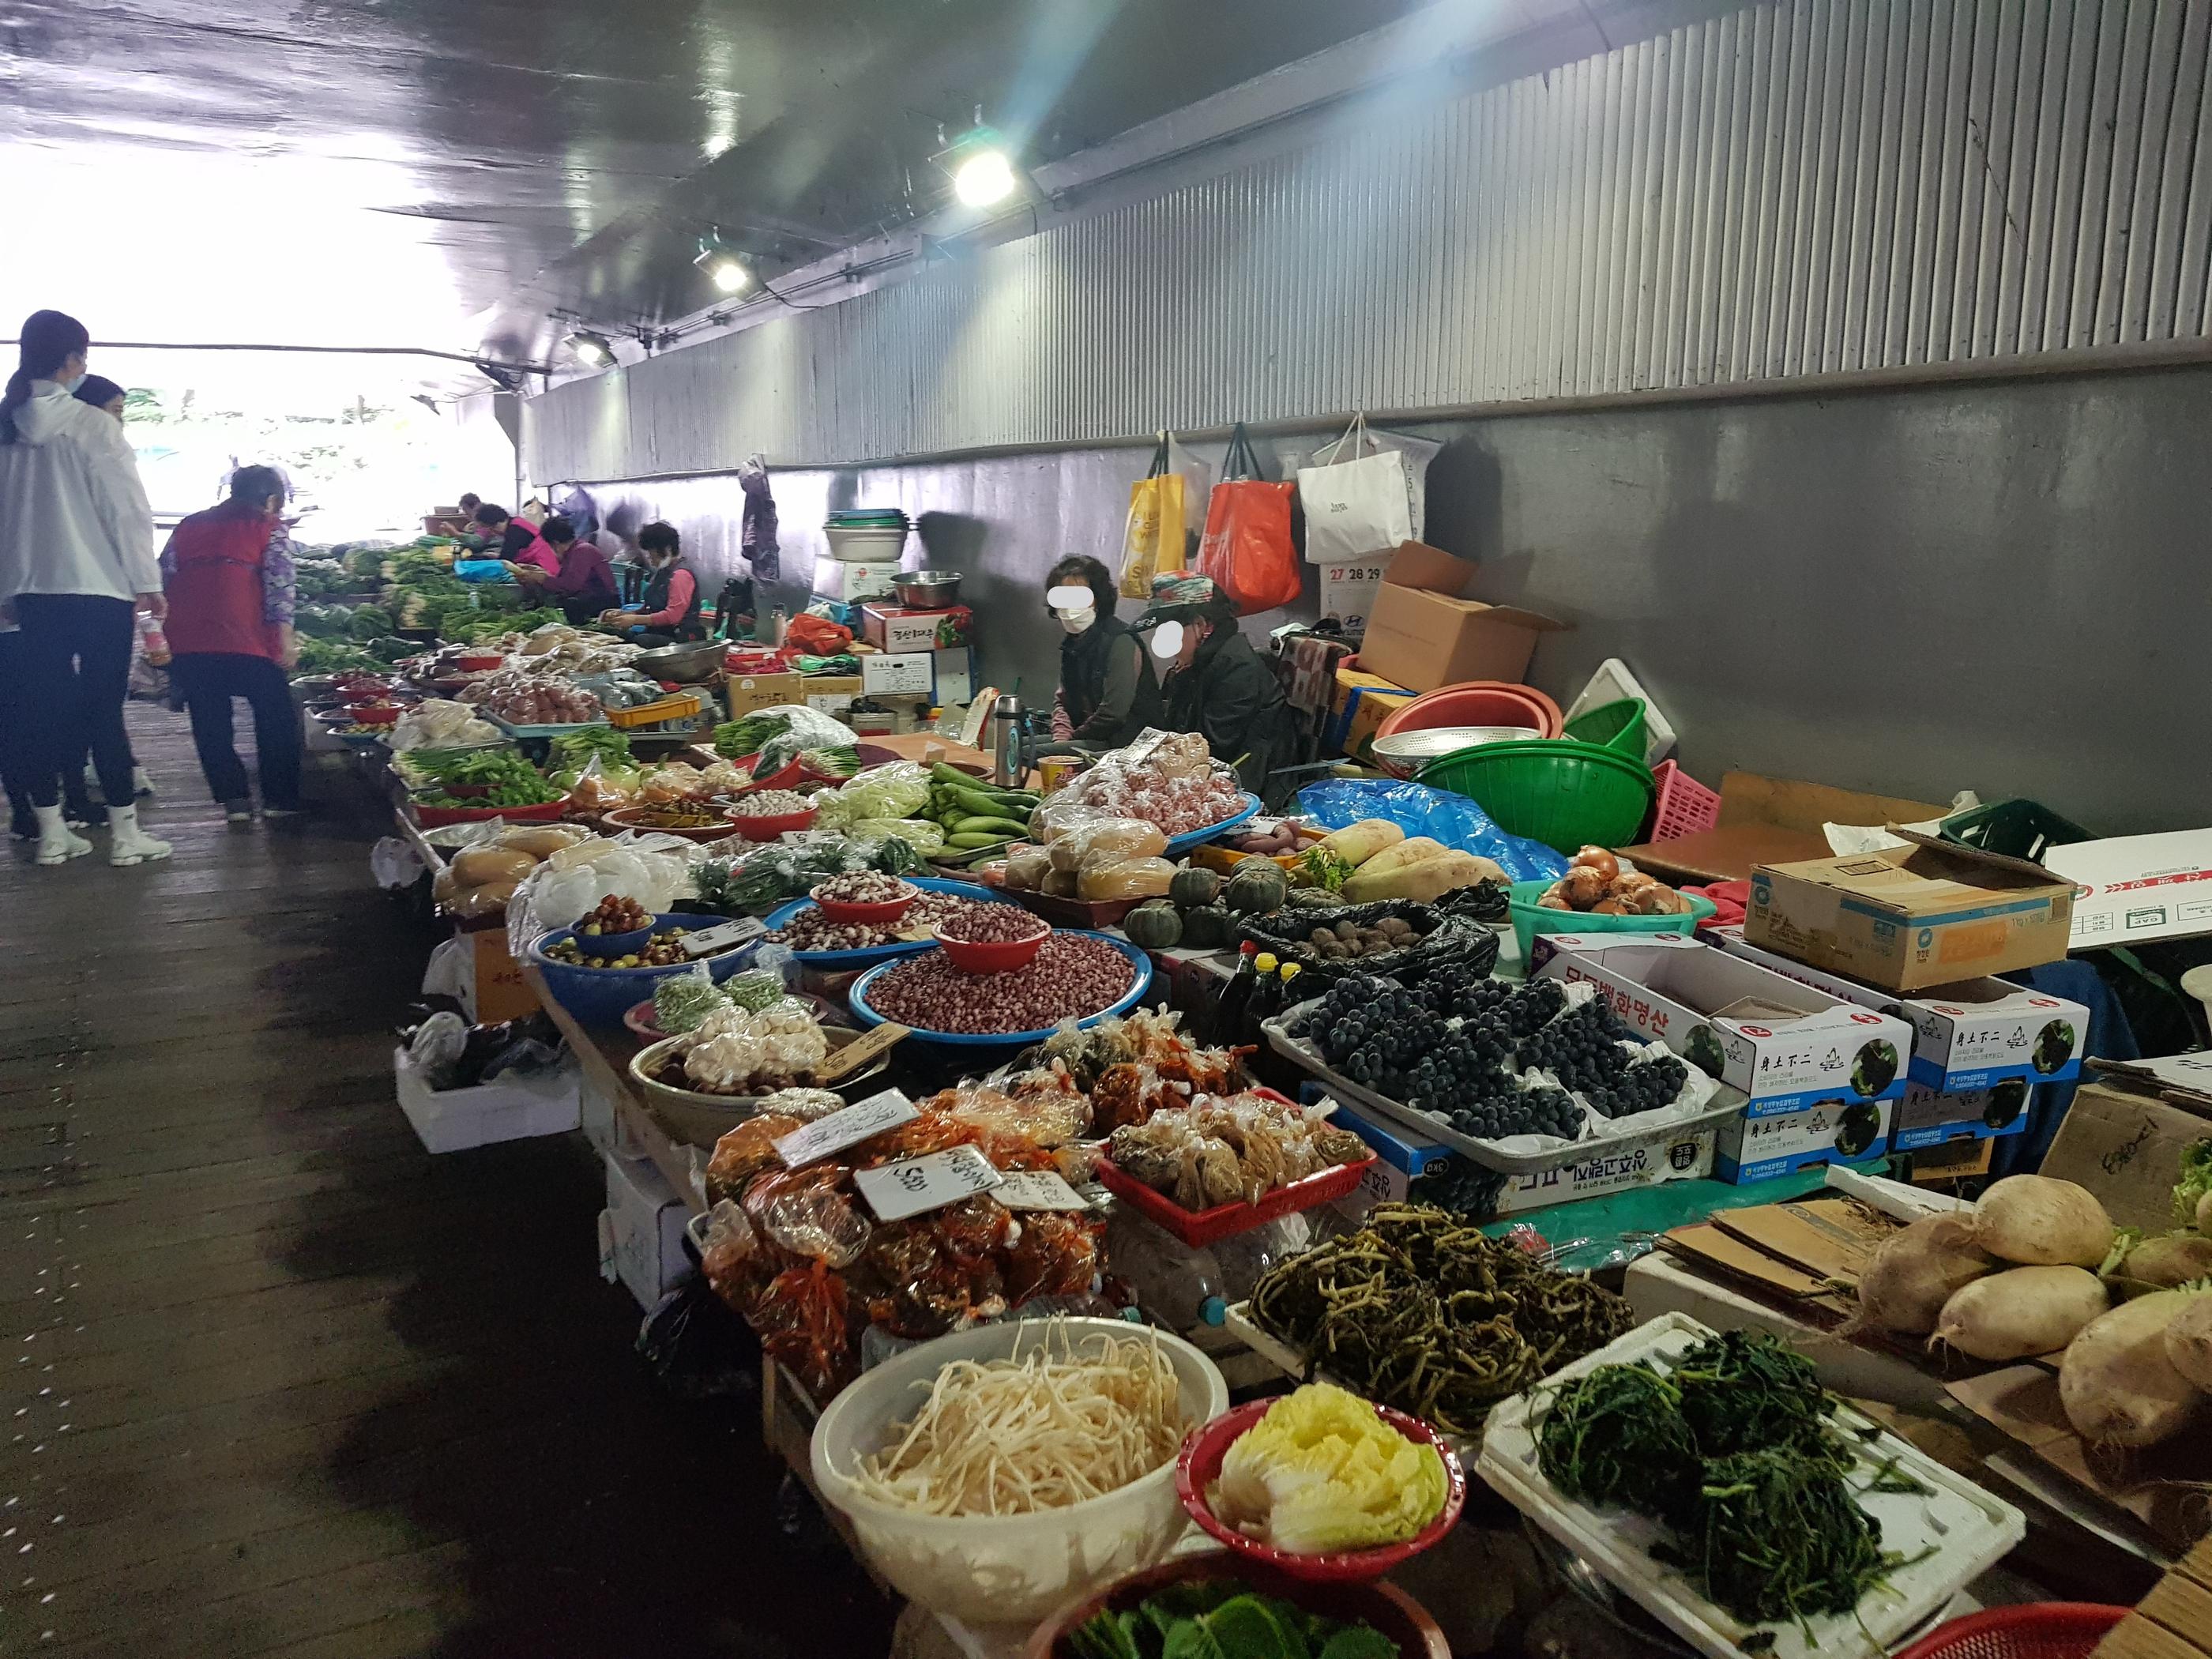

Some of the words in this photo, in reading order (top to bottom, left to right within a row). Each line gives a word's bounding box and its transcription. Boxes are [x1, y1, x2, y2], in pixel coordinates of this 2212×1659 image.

[1330, 568, 1345, 580] 27
[1349, 568, 1364, 580] 28
[1367, 568, 1380, 580] 29
[1956, 1031, 2000, 1047] 身土不二
[1760, 1054, 1811, 1072] 身土不二
[1750, 1119, 1798, 1138] 身土不二
